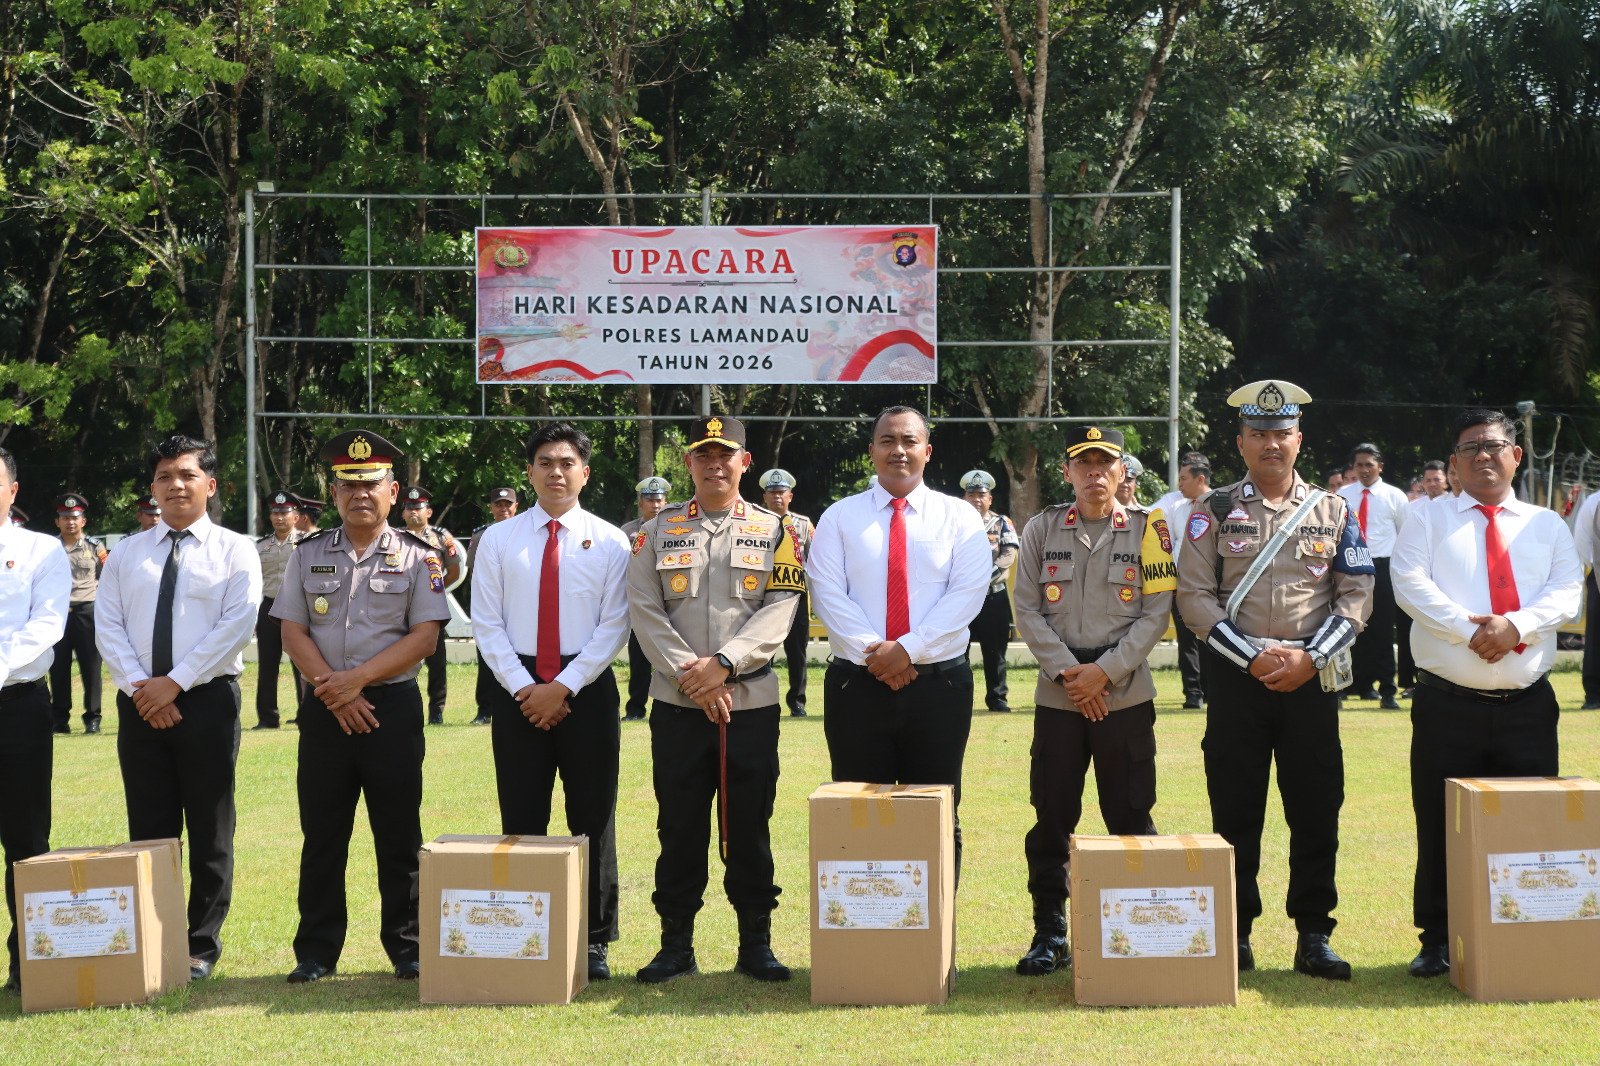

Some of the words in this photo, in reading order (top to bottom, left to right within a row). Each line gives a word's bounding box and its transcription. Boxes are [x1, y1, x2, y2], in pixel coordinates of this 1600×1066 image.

[611, 248, 796, 275] UPACARA
[513, 295, 576, 315] HARI
[587, 294, 749, 315] KESADARAN
[759, 294, 899, 315] NASIONAL
[602, 328, 682, 344] POLRES
[689, 328, 810, 344] LAMANDAU
[637, 354, 709, 370] TAHUN
[718, 354, 774, 370] 2026
[661, 539, 696, 549] JOKO.H
[736, 538, 771, 549] POLRI
